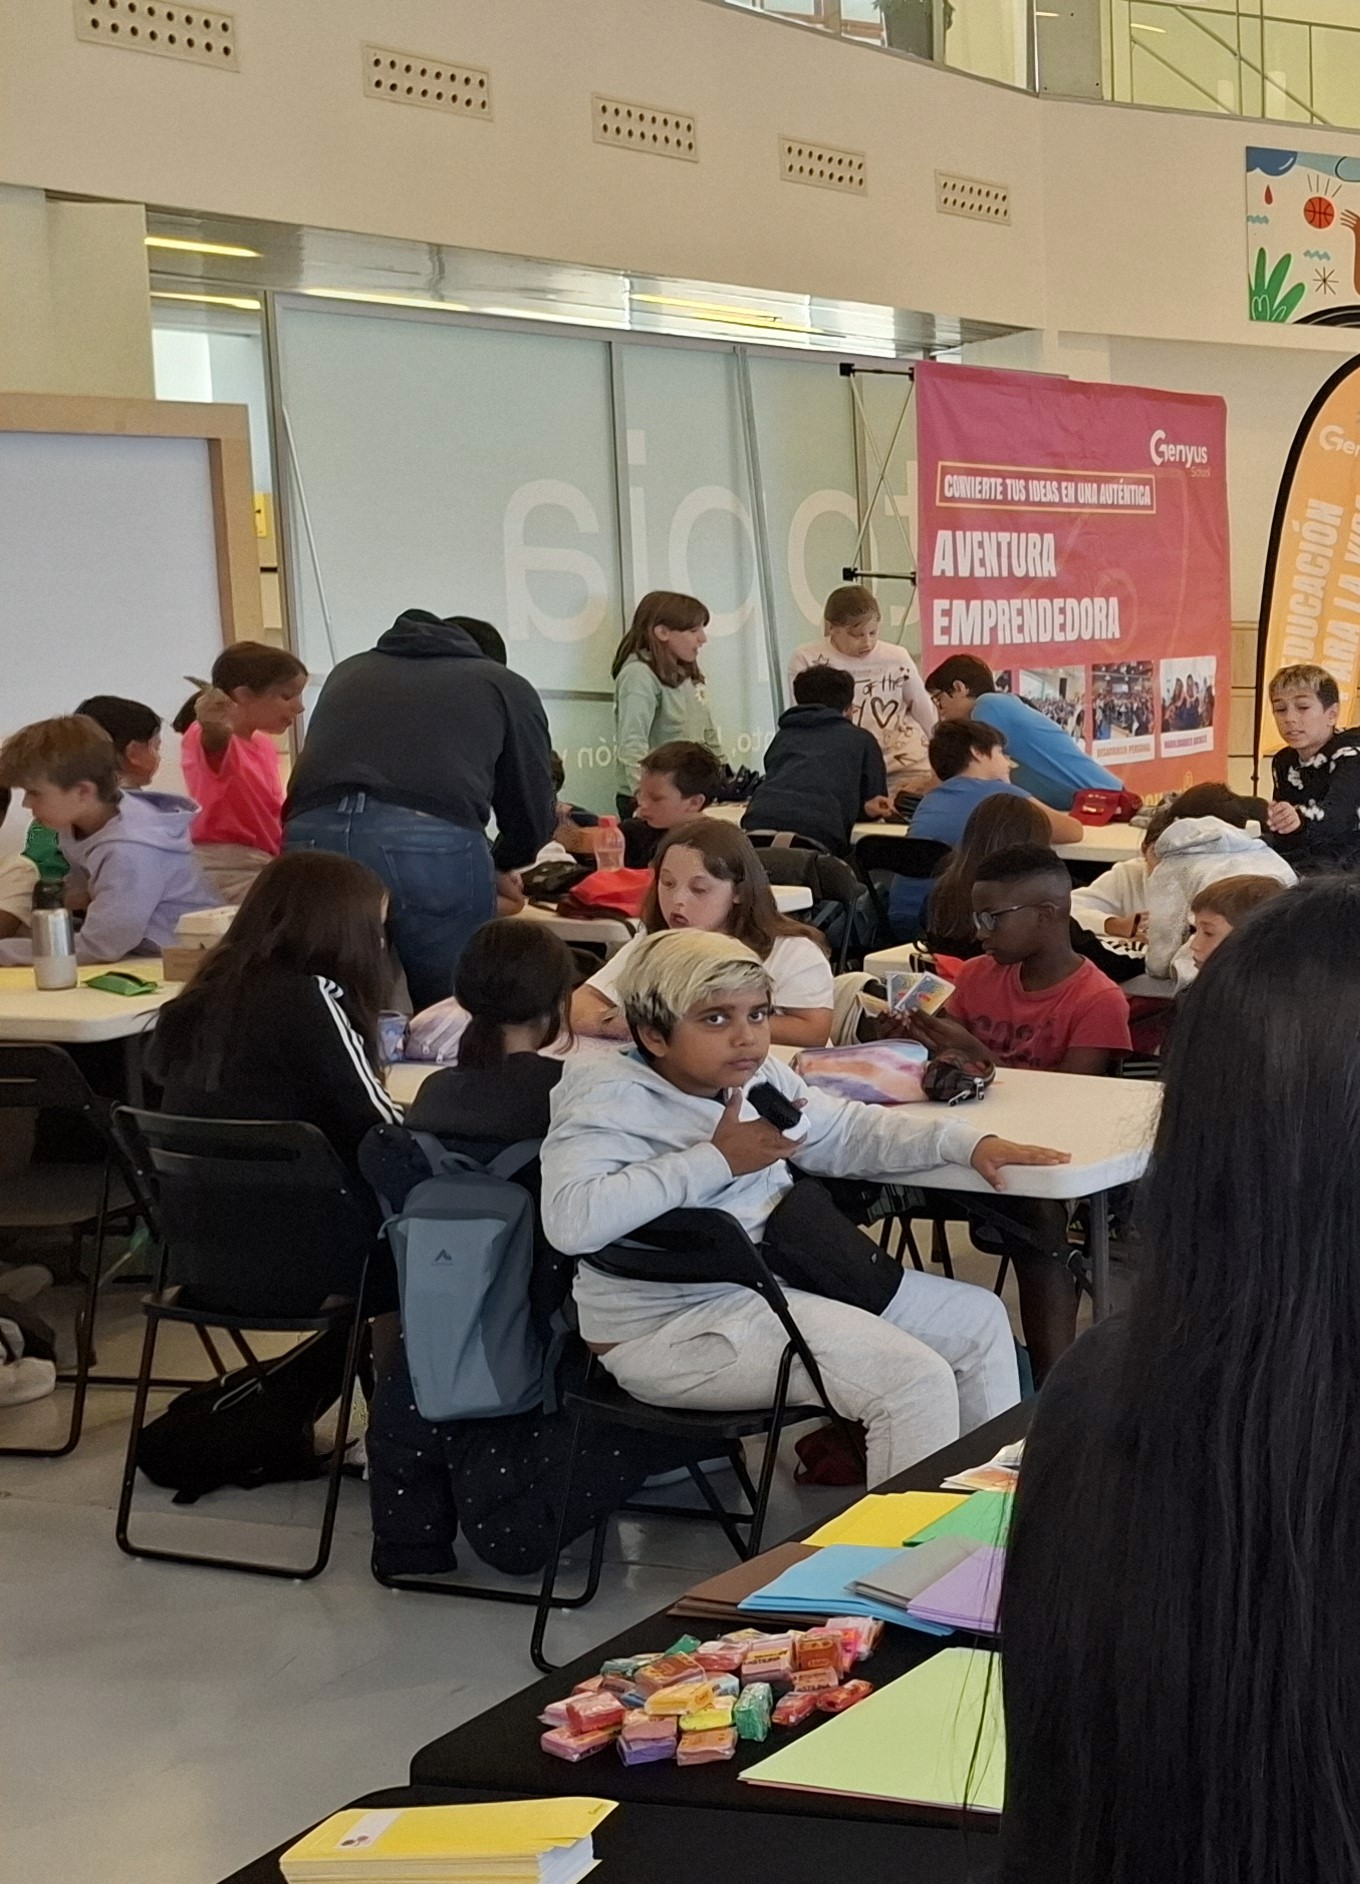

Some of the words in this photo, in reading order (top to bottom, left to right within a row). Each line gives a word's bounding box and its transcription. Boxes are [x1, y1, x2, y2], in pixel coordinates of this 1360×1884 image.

[1150, 429, 1208, 466] Genyus
[944, 474, 1003, 500] CONVIERTE
[1005, 478, 1026, 502] TUS
[1029, 480, 1059, 504] IDEAS
[1061, 482, 1076, 503] EN
[1078, 482, 1098, 505] UNA
[1100, 478, 1151, 506] AUTÉNTICA
[932, 530, 1057, 577] AVENTURA
[933, 597, 1121, 646] EMPRENDEDORA
[1321, 618, 1360, 702] ARA
